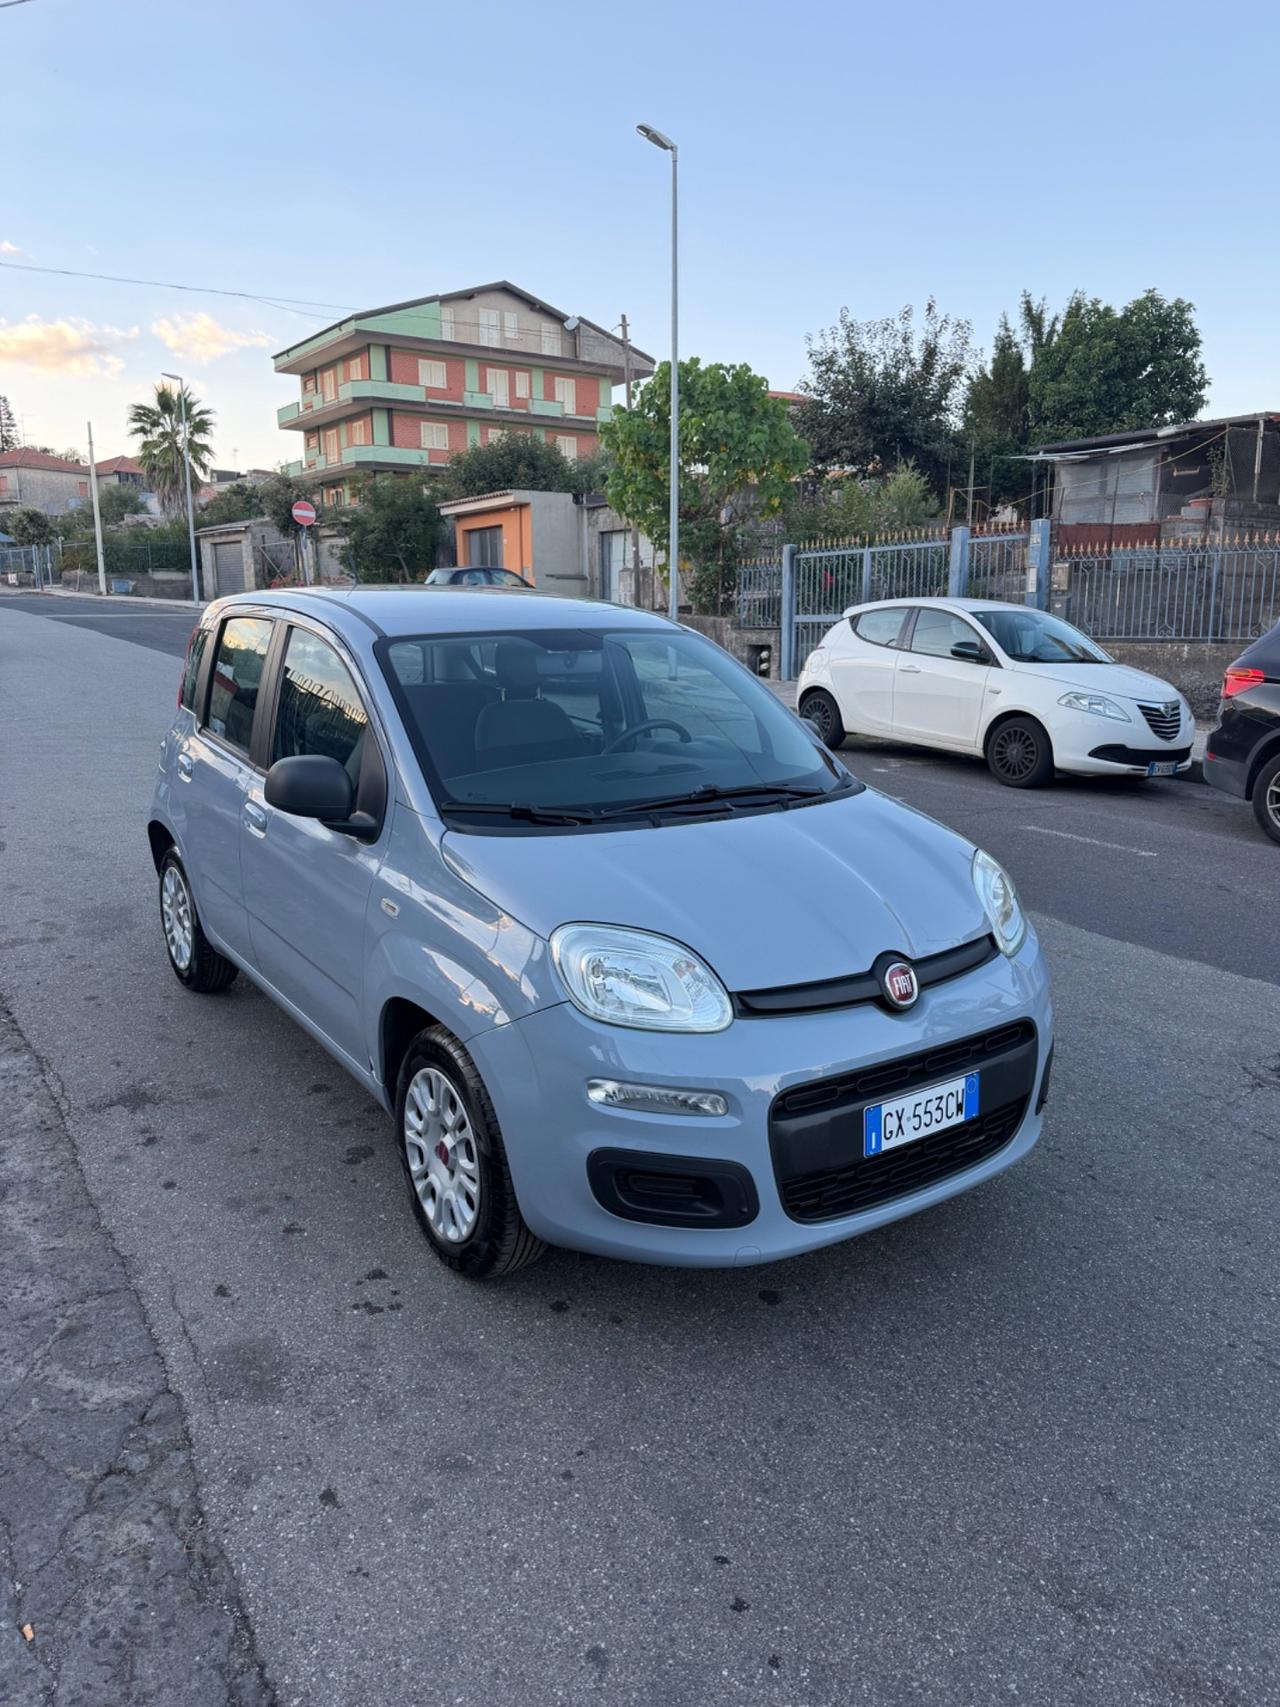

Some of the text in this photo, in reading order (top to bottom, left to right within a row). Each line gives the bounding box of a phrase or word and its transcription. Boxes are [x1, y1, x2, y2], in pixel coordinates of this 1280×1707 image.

[892, 974, 912, 996] FIAT
[883, 1107, 905, 1141] GX
[912, 1088, 965, 1131] 553CW
